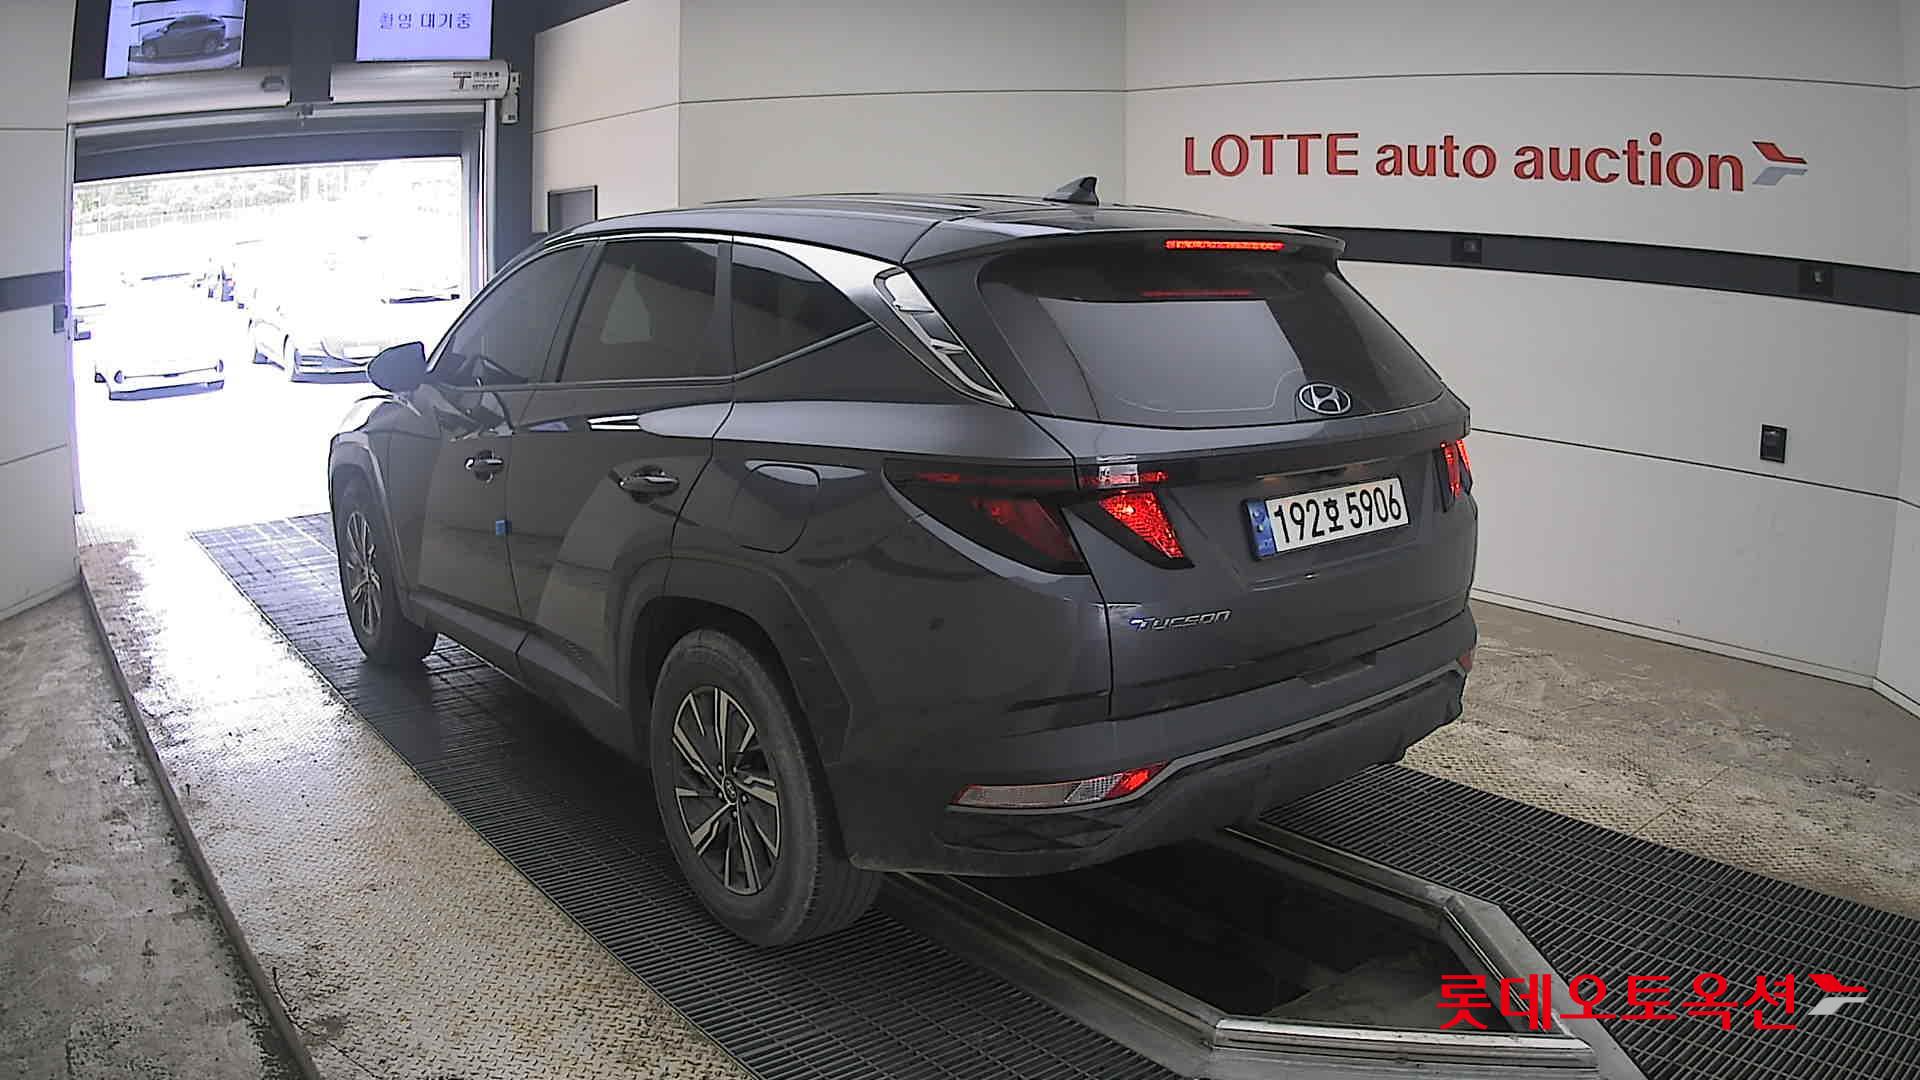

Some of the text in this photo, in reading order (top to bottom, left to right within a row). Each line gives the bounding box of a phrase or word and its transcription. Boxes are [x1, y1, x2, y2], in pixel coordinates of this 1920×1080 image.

[1184, 132, 1744, 192] LOTTE auto auction
[1274, 484, 1401, 543] 192호 5906
